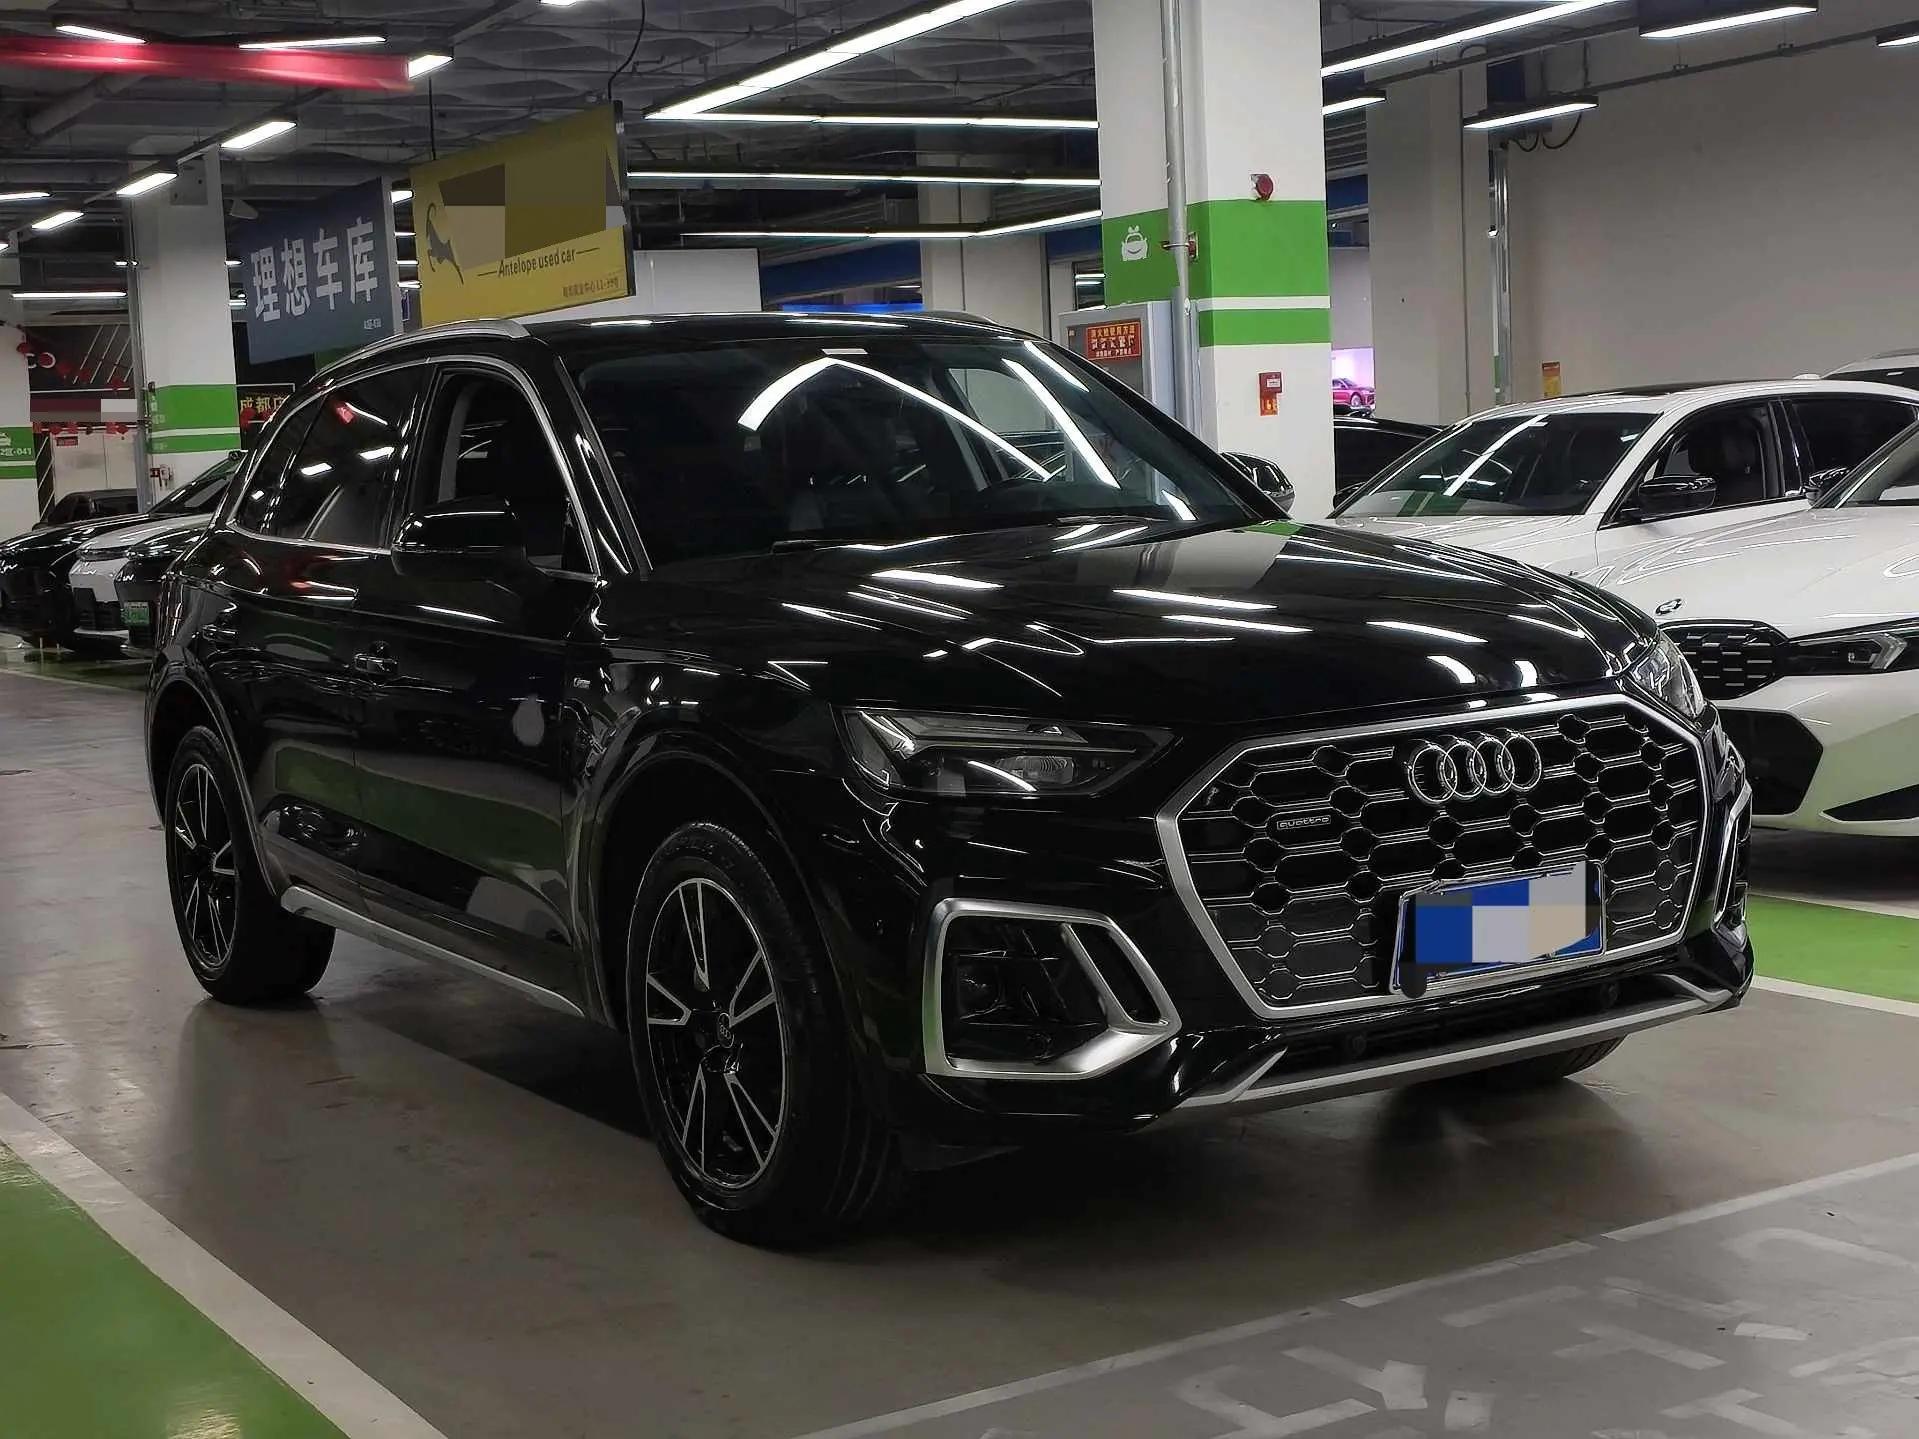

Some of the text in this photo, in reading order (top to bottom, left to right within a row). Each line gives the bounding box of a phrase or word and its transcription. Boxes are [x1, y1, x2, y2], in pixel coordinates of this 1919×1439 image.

[251, 216, 378, 322] 理想车库
[498, 249, 576, 278] Antelope used car
[1279, 817, 1330, 828] quattro
